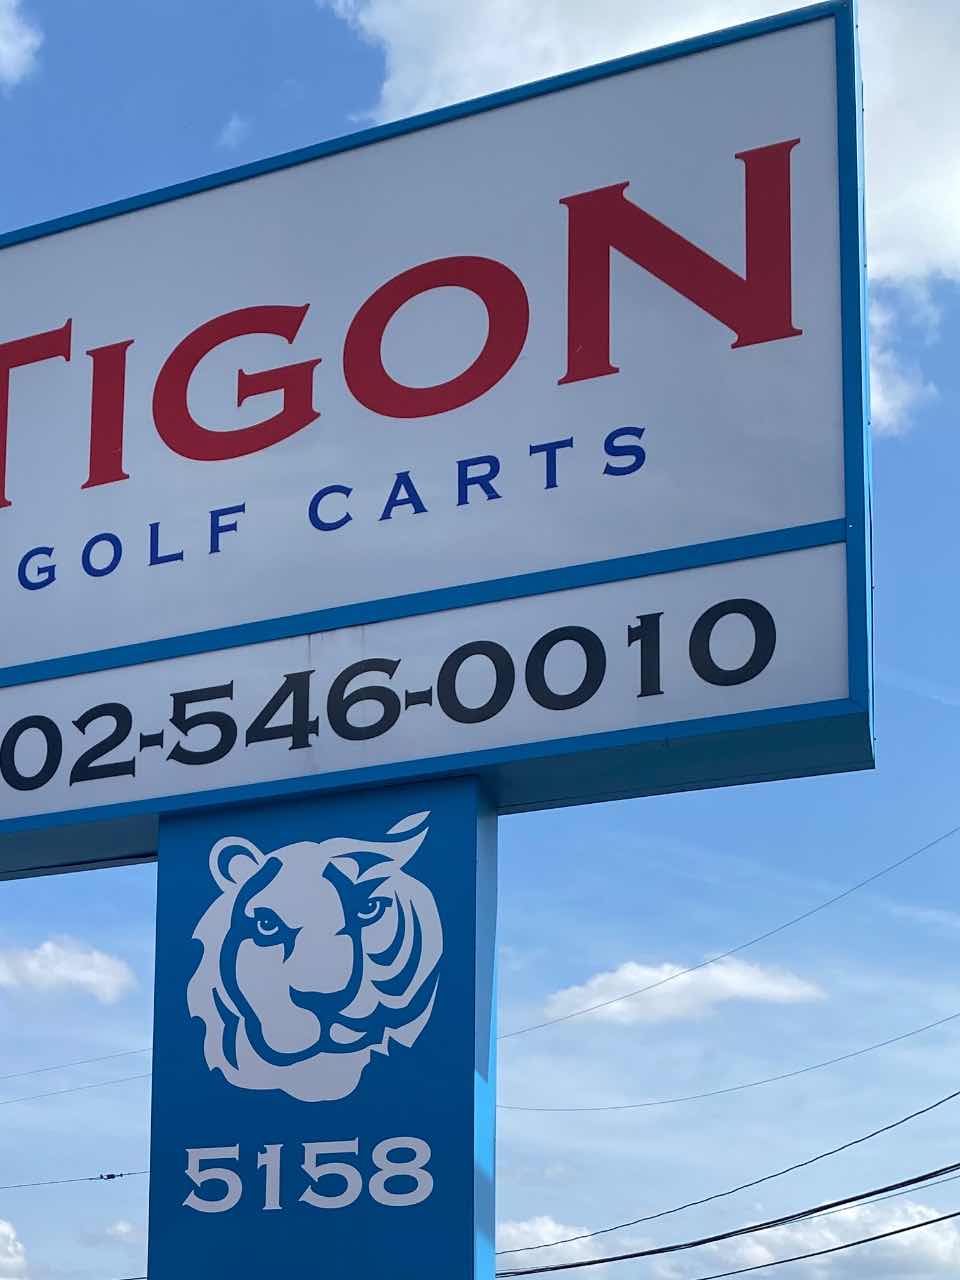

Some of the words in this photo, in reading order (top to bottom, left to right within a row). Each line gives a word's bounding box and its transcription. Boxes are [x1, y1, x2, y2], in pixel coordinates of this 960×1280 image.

[17, 502, 246, 591] GOLF
[308, 426, 646, 532] CARTS
[182, 1136, 434, 1213] 5158
